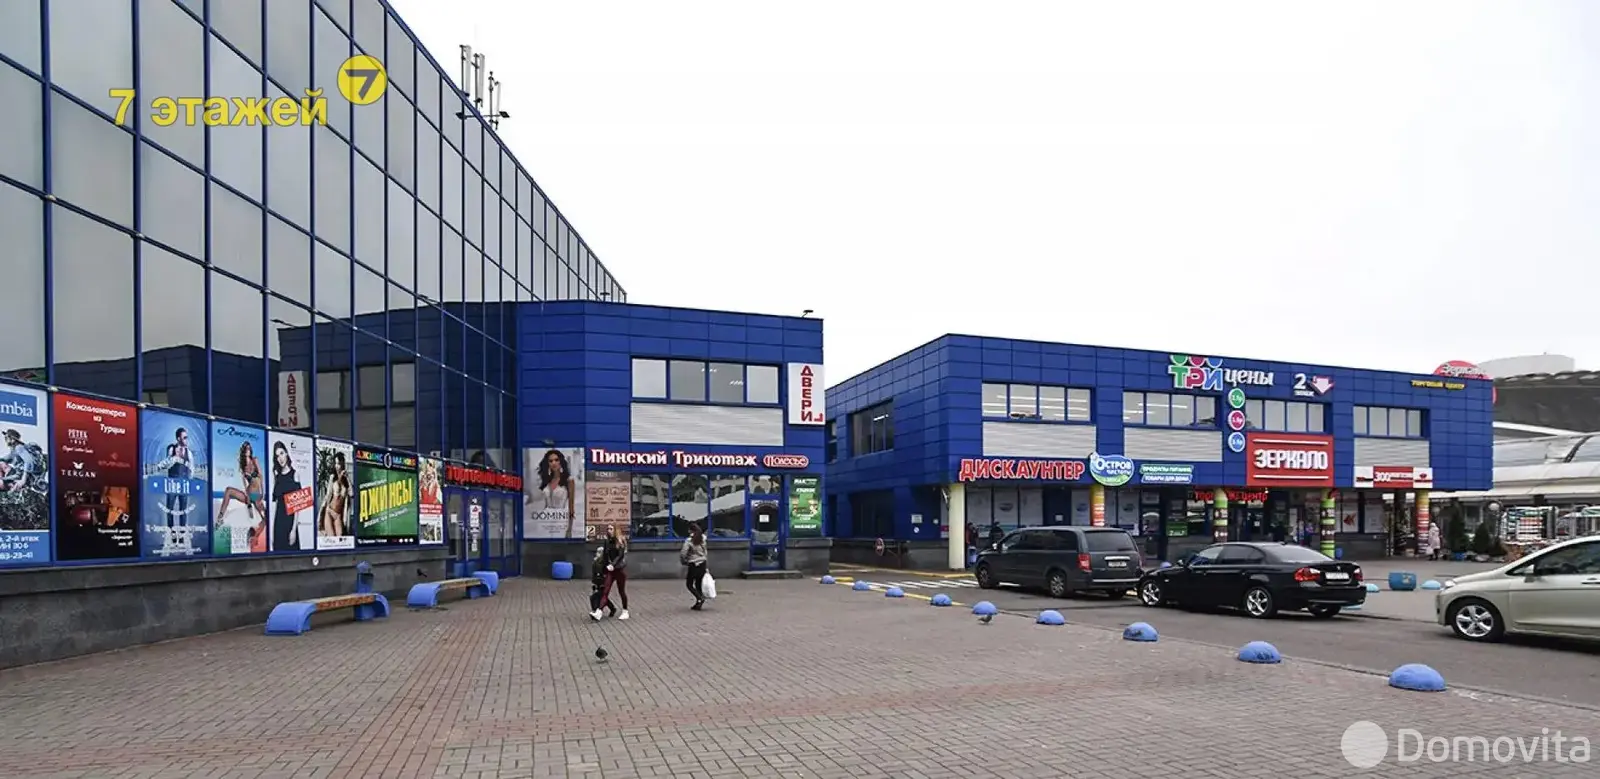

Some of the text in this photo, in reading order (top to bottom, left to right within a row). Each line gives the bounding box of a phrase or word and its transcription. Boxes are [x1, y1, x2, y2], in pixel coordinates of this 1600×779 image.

[1168, 365, 1274, 391] ТРИ цены
[1293, 373, 1306, 390] 2
[801, 365, 814, 422] ДВЕРИ
[0, 401, 34, 418] mbia
[591, 449, 758, 469] Пинский Трикотаж
[1254, 449, 1329, 471] ЗЕРКАЛО
[61, 469, 97, 478] TERGAN
[959, 459, 1085, 482] ДИСКАУНТЕР
[164, 478, 190, 494] Like it
[359, 478, 413, 523] ДЖИНСЫ
